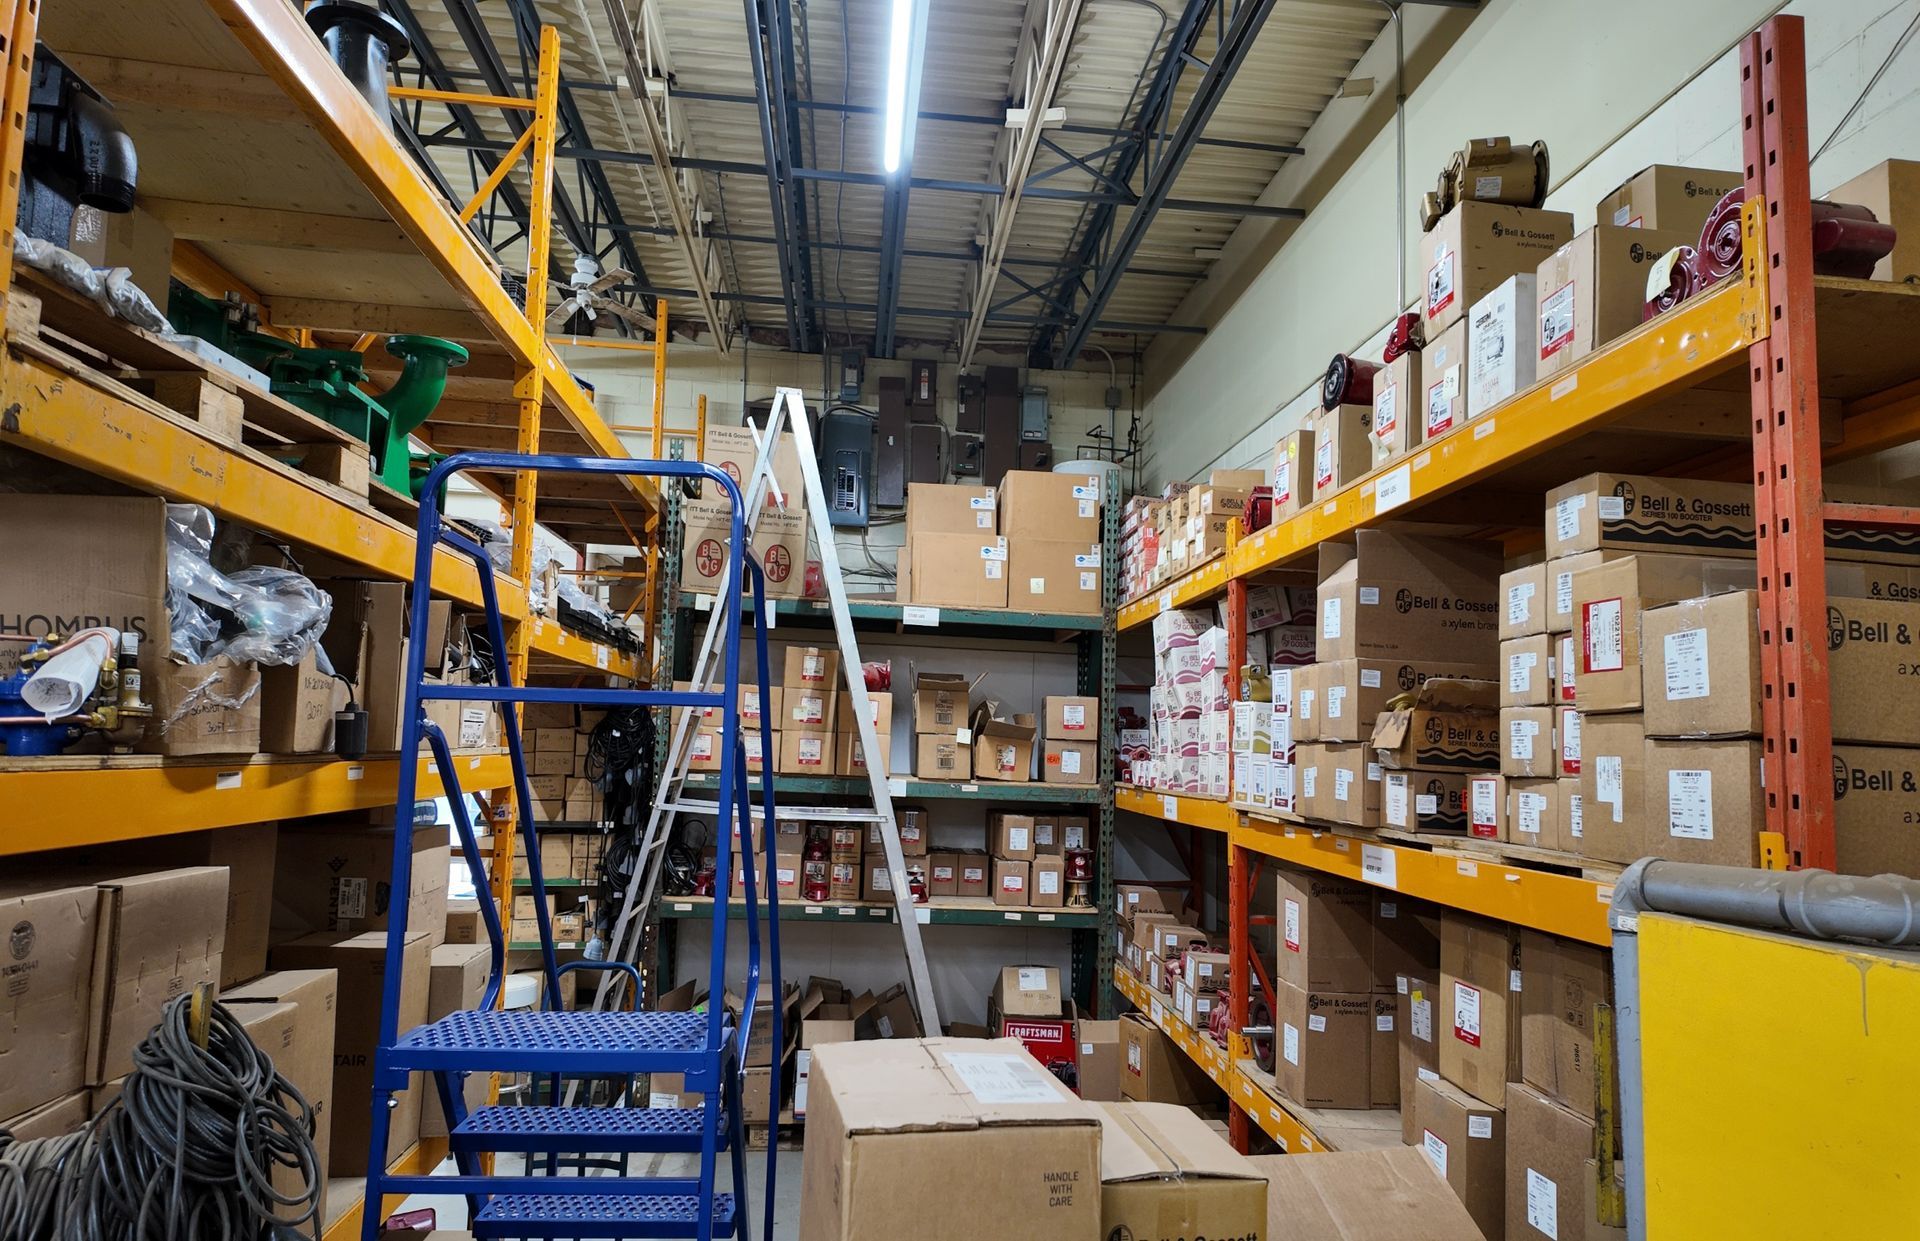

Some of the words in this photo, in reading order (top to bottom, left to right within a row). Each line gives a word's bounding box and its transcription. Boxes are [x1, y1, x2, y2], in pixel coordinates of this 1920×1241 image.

[1504, 227, 1519, 238] Bell
[1527, 230, 1555, 241] Gossett
[1641, 495, 1670, 511] Bell
[1676, 498, 1687, 513] &
[1692, 499, 1751, 518] Gossett
[1641, 511, 1666, 519] SERIES
[1680, 513, 1713, 522] BOOSTER
[1871, 581, 1882, 597] &
[1414, 596, 1438, 610] Bell
[1441, 598, 1450, 610] &
[1448, 618, 1476, 631] xylem
[1848, 619, 1889, 644] Bell
[1895, 623, 1911, 645] &
[1898, 662, 1907, 675] a
[1447, 727, 1471, 740] Bell
[1475, 730, 1485, 741] &
[1851, 768, 1893, 792] Bell
[1901, 771, 1916, 793] &
[1319, 999, 1333, 1008] Bell
[1334, 1000, 1341, 1008] &
[1341, 1000, 1369, 1009] Gossett
[1009, 1026, 1060, 1038] CRAFTSMAN
[1043, 1171, 1079, 1183] HANDLE
[1050, 1184, 1073, 1194] WITH
[1049, 1196, 1073, 1207] CARE
